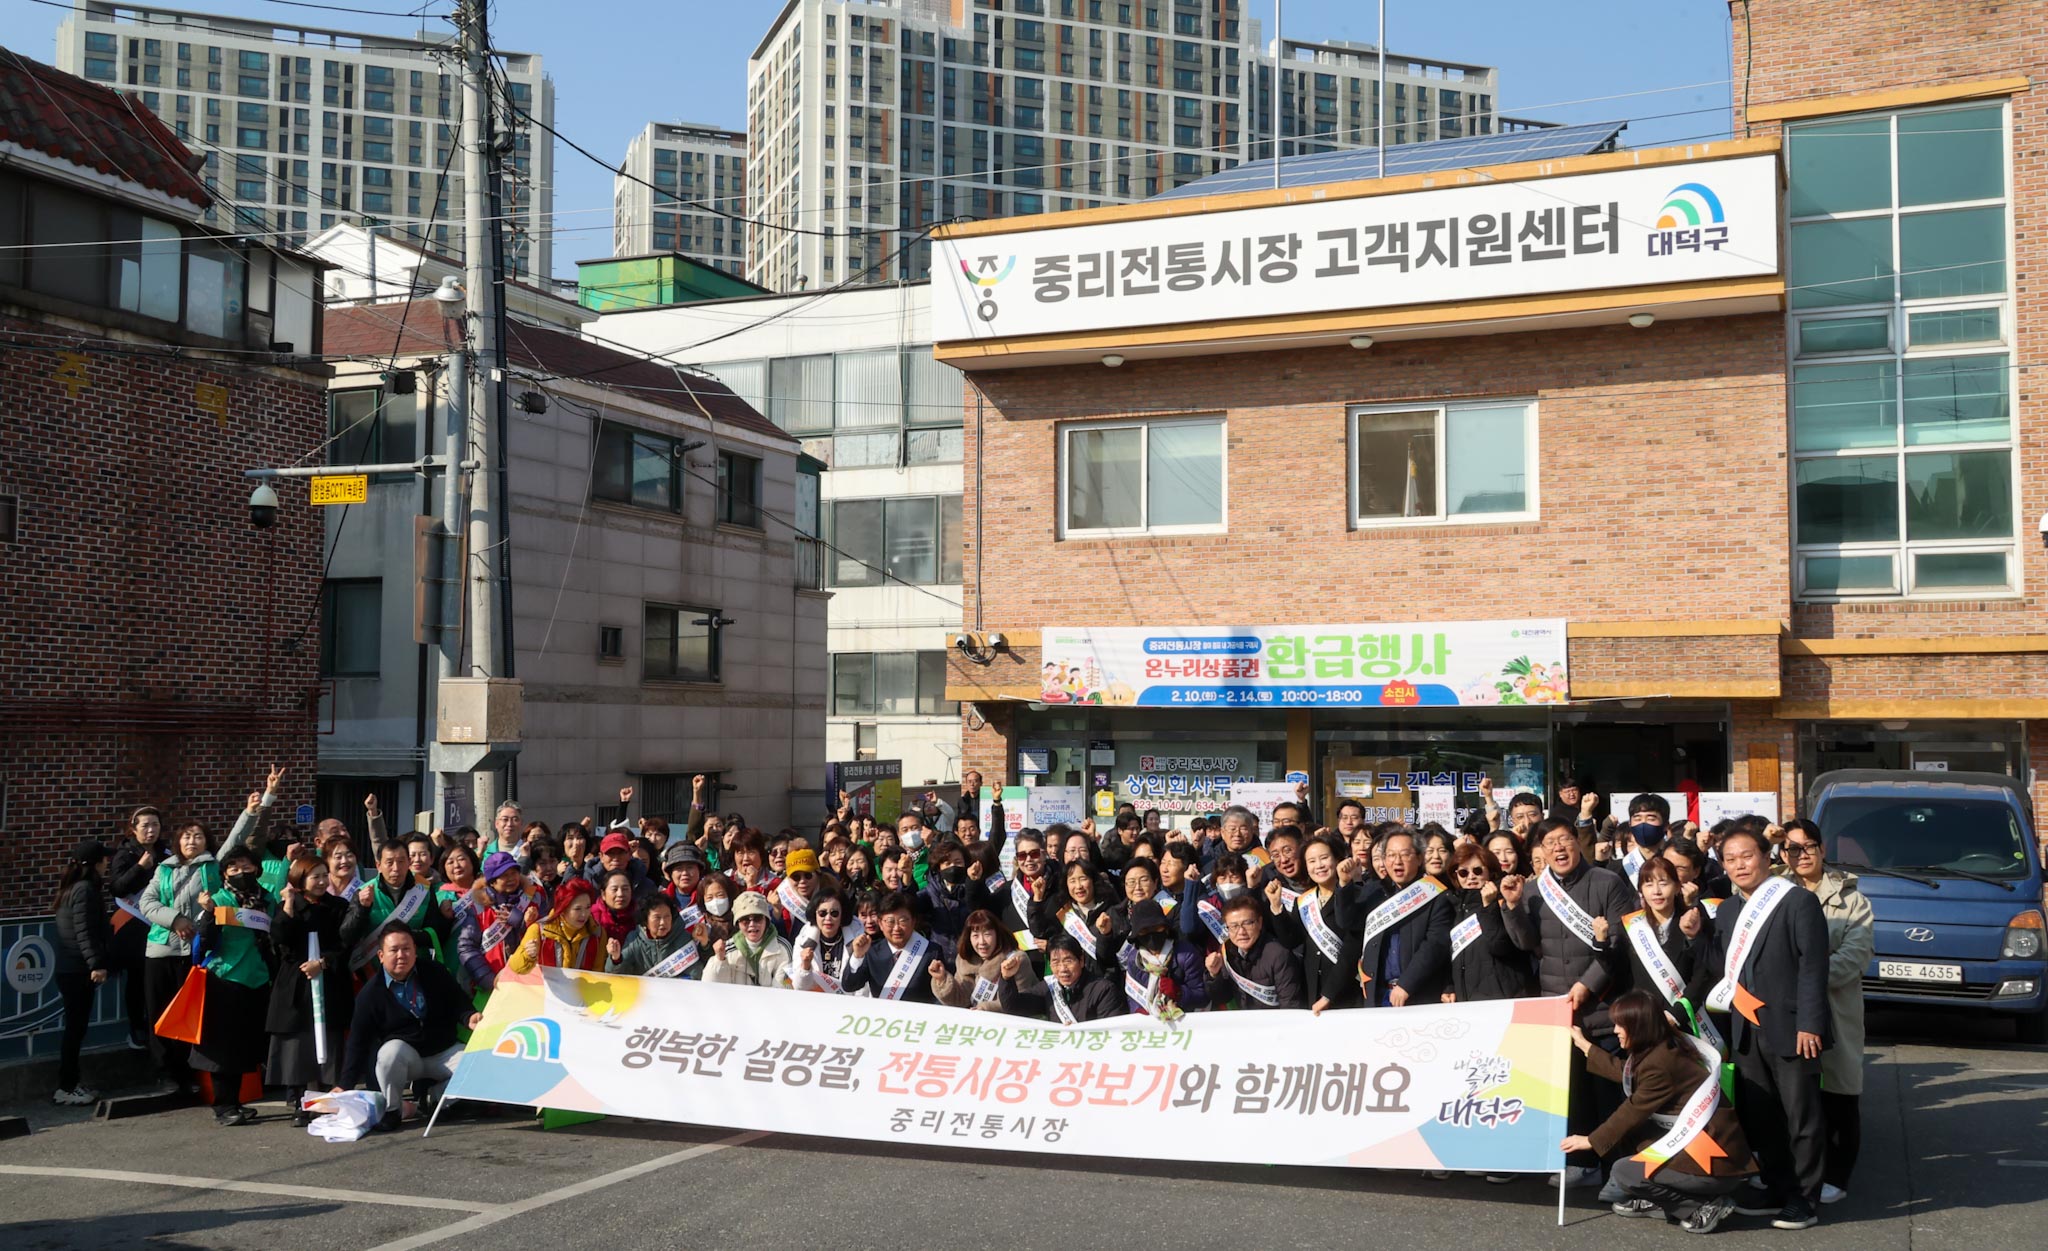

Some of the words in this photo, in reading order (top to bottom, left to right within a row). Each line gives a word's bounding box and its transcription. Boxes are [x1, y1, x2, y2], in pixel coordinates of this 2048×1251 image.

[1032, 233, 1302, 303] 중리전통시장
[1315, 202, 1619, 278] 고객지원센터
[1647, 226, 1729, 257] 대덕구
[1149, 641, 1202, 651] 중리전통시장
[1266, 633, 1452, 679] 환급행사
[1145, 658, 1260, 679] 온누리상품권
[1281, 690, 1362, 702] 10:00~18:00
[1384, 688, 1415, 699] 소진시
[1166, 756, 1238, 771] 중리전통시장
[1134, 800, 1181, 811] 623-1040
[1886, 963, 1912, 977] 85도
[1919, 966, 1954, 979] 4635
[836, 1014, 927, 1044] 2026년
[934, 1020, 1005, 1047] 설맞이
[1014, 1028, 1112, 1052] 전통시장
[1119, 1028, 1193, 1052] 장보기
[621, 1025, 735, 1079] 행복한
[742, 1040, 865, 1093] 설명절,
[877, 1051, 1041, 1104] 전통시장
[1049, 1061, 1221, 1114] 장보기와
[1233, 1062, 1412, 1117] 함께해요
[1439, 1097, 1522, 1126] 대덕구
[889, 1107, 1069, 1144] 중리전통시장
